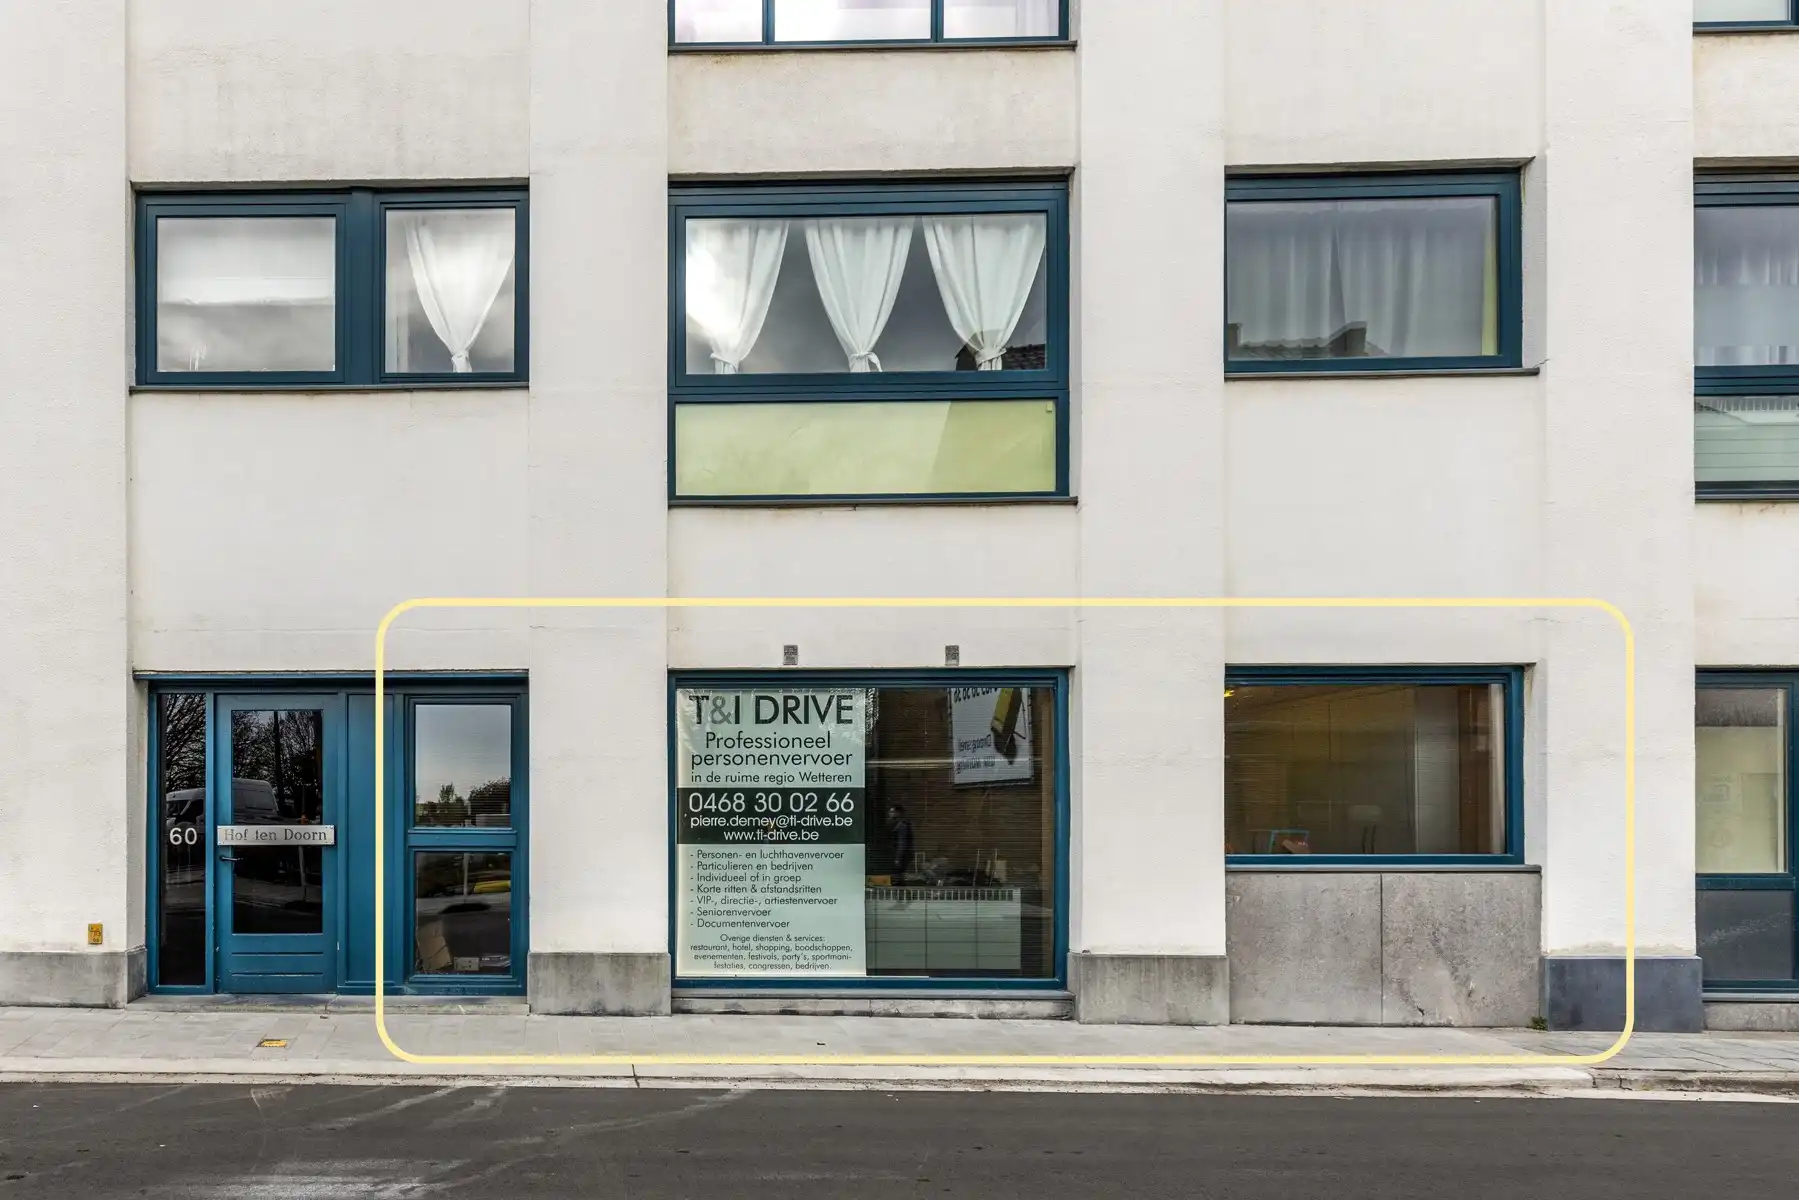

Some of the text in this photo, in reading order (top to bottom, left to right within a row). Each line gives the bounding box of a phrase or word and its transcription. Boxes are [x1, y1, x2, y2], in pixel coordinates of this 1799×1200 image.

[689, 695, 853, 725] T&I DRIVE
[706, 731, 831, 749] Professioneel
[691, 753, 853, 770] personenvervoer
[691, 771, 852, 785] in de ruime regio Wetteren
[689, 792, 855, 812] 0468 30 02 66
[169, 828, 198, 845] 60
[224, 829, 327, 841] Hof ten Doorn
[724, 829, 819, 841] www.ti-drive.be
[697, 849, 742, 859] Personen-
[760, 849, 845, 859] luchthavenvervoer
[697, 861, 753, 870] Particulieren
[770, 861, 813, 872] bedrijven
[697, 872, 802, 884] Individueel of in groep
[697, 883, 822, 893] Korte ritten & afstandsritten
[764, 896, 838, 905] artiestenvervoer
[697, 908, 772, 917] Seniorenvervoer
[697, 918, 790, 928] Documentenvervoer
[720, 933, 750, 943] Overige
[752, 933, 784, 942] diensten
[785, 933, 792, 942] &
